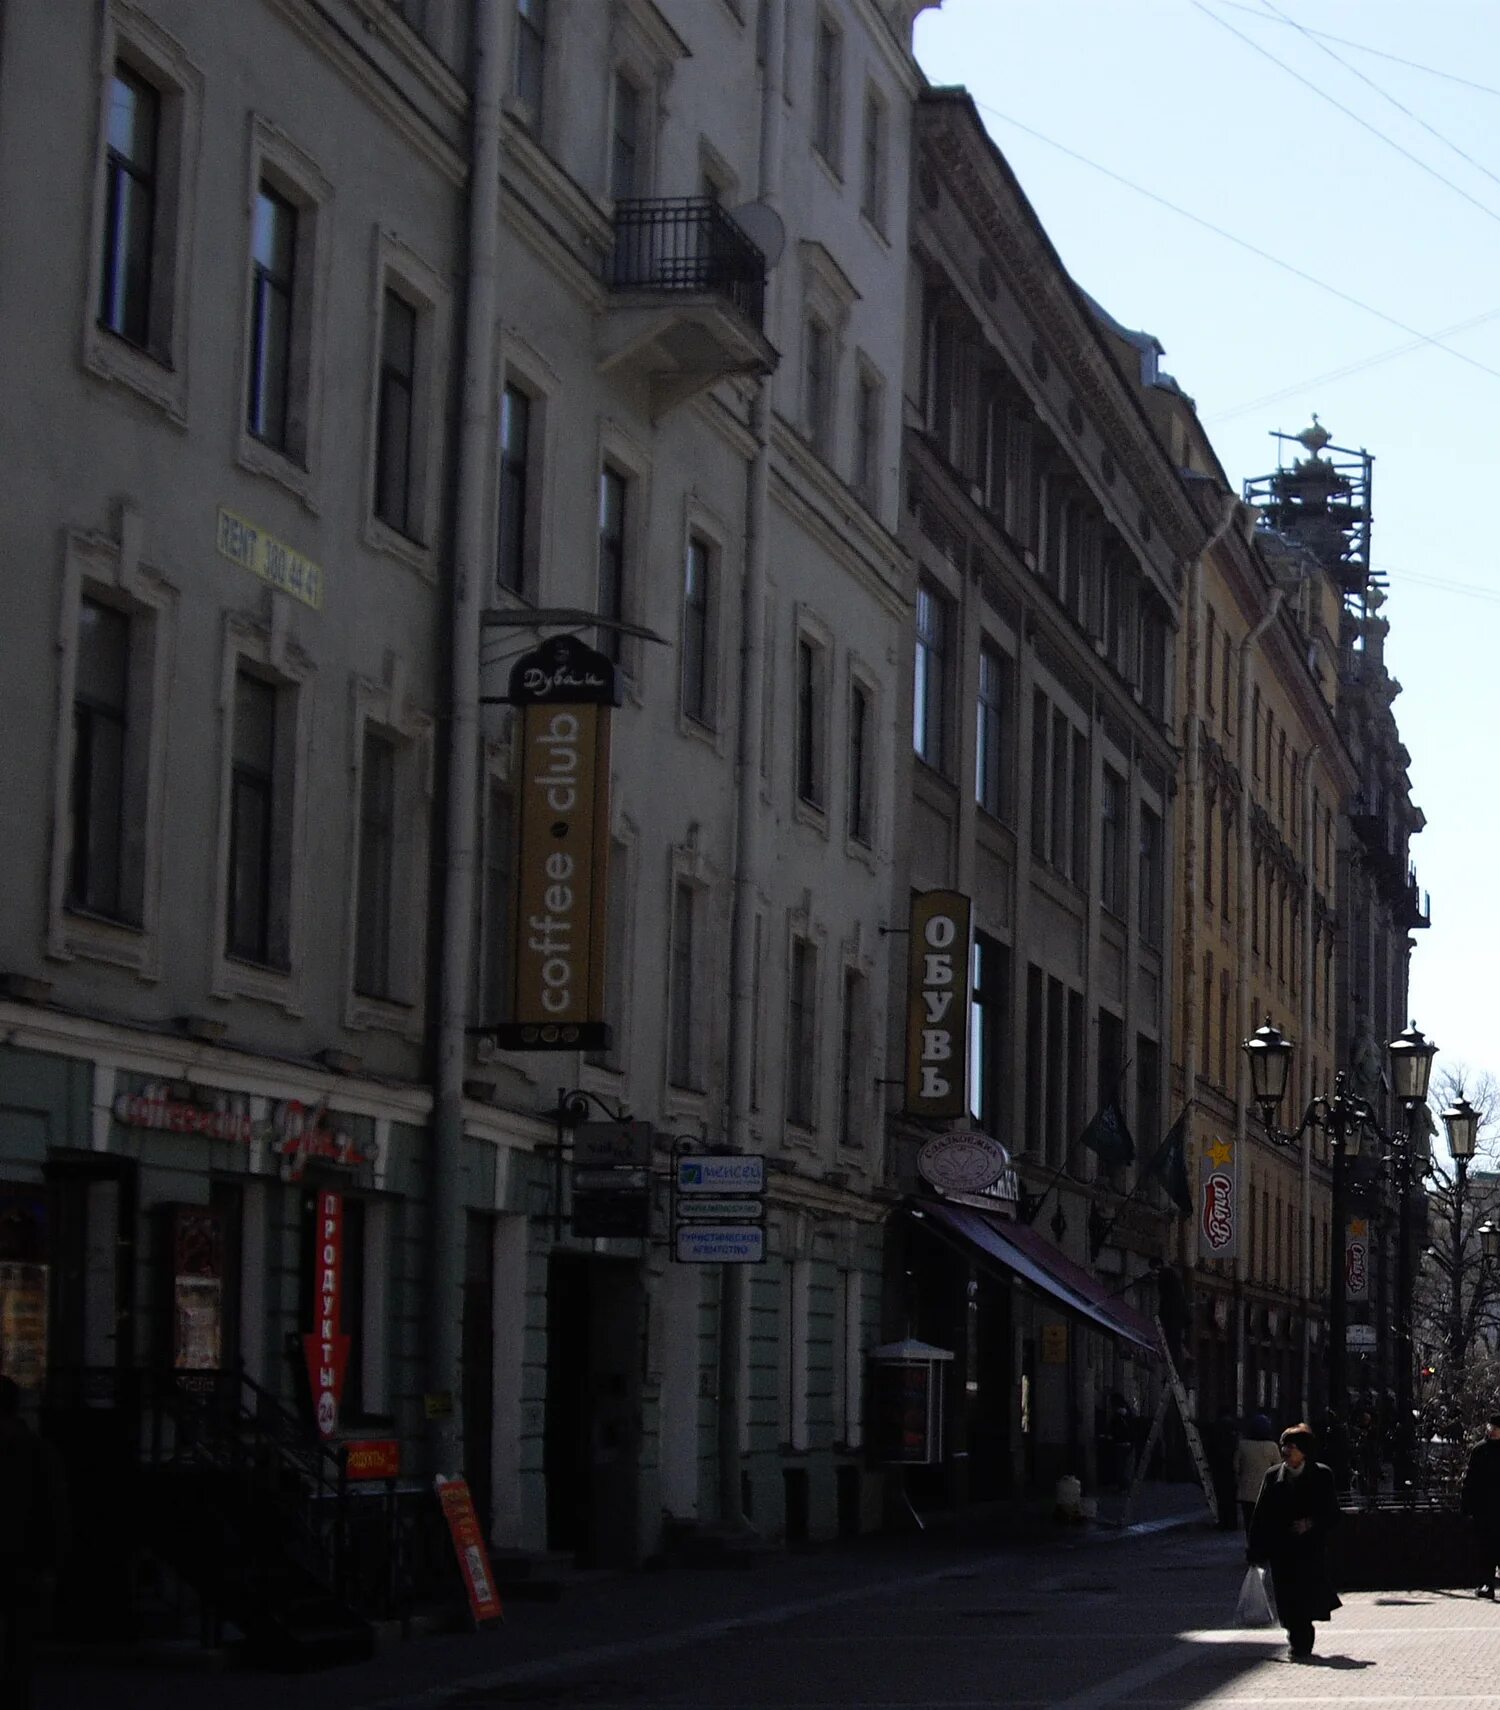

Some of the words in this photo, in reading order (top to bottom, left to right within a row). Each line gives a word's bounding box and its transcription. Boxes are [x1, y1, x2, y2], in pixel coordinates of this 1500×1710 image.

[221, 511, 258, 571] RENT
[534, 712, 579, 812] club
[528, 851, 575, 1013] coffee
[919, 914, 956, 1098] ОБУВЬ
[1212, 1175, 1232, 1220] Carl's
[320, 1194, 338, 1387] ПРОДУКТЫ
